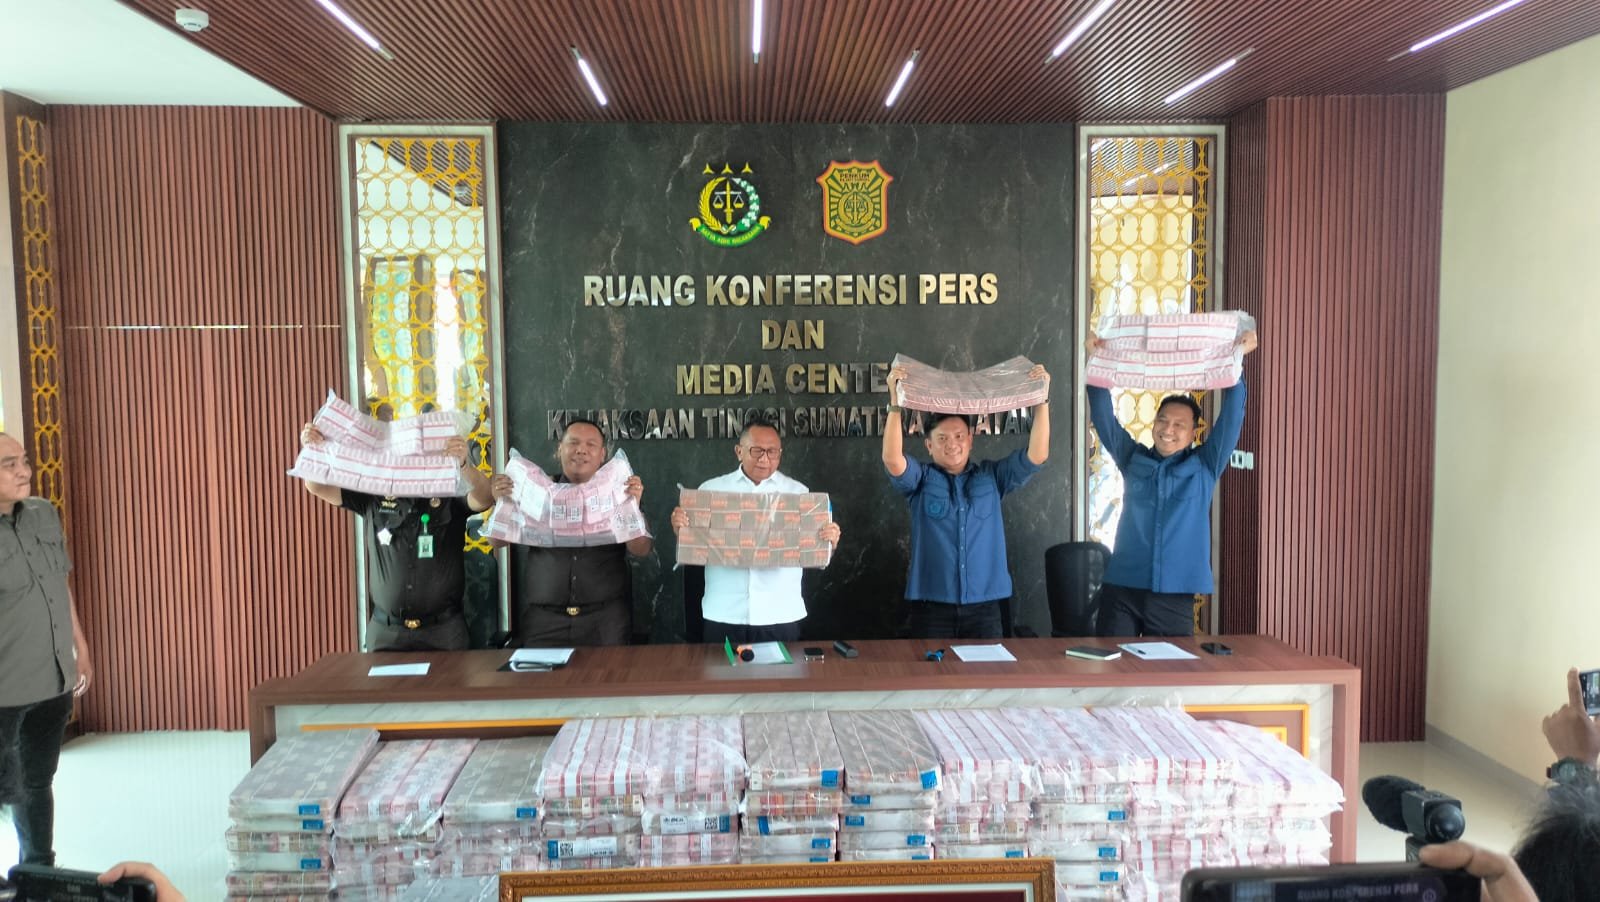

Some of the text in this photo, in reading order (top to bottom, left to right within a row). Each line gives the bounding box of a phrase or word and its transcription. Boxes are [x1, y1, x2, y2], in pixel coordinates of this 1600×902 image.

[583, 272, 999, 307] RUANG KONFERENSI PERS
[761, 319, 825, 351] DAN
[676, 362, 889, 396] MEDIA CENTE
[794, 406, 926, 438] SUMATEA
